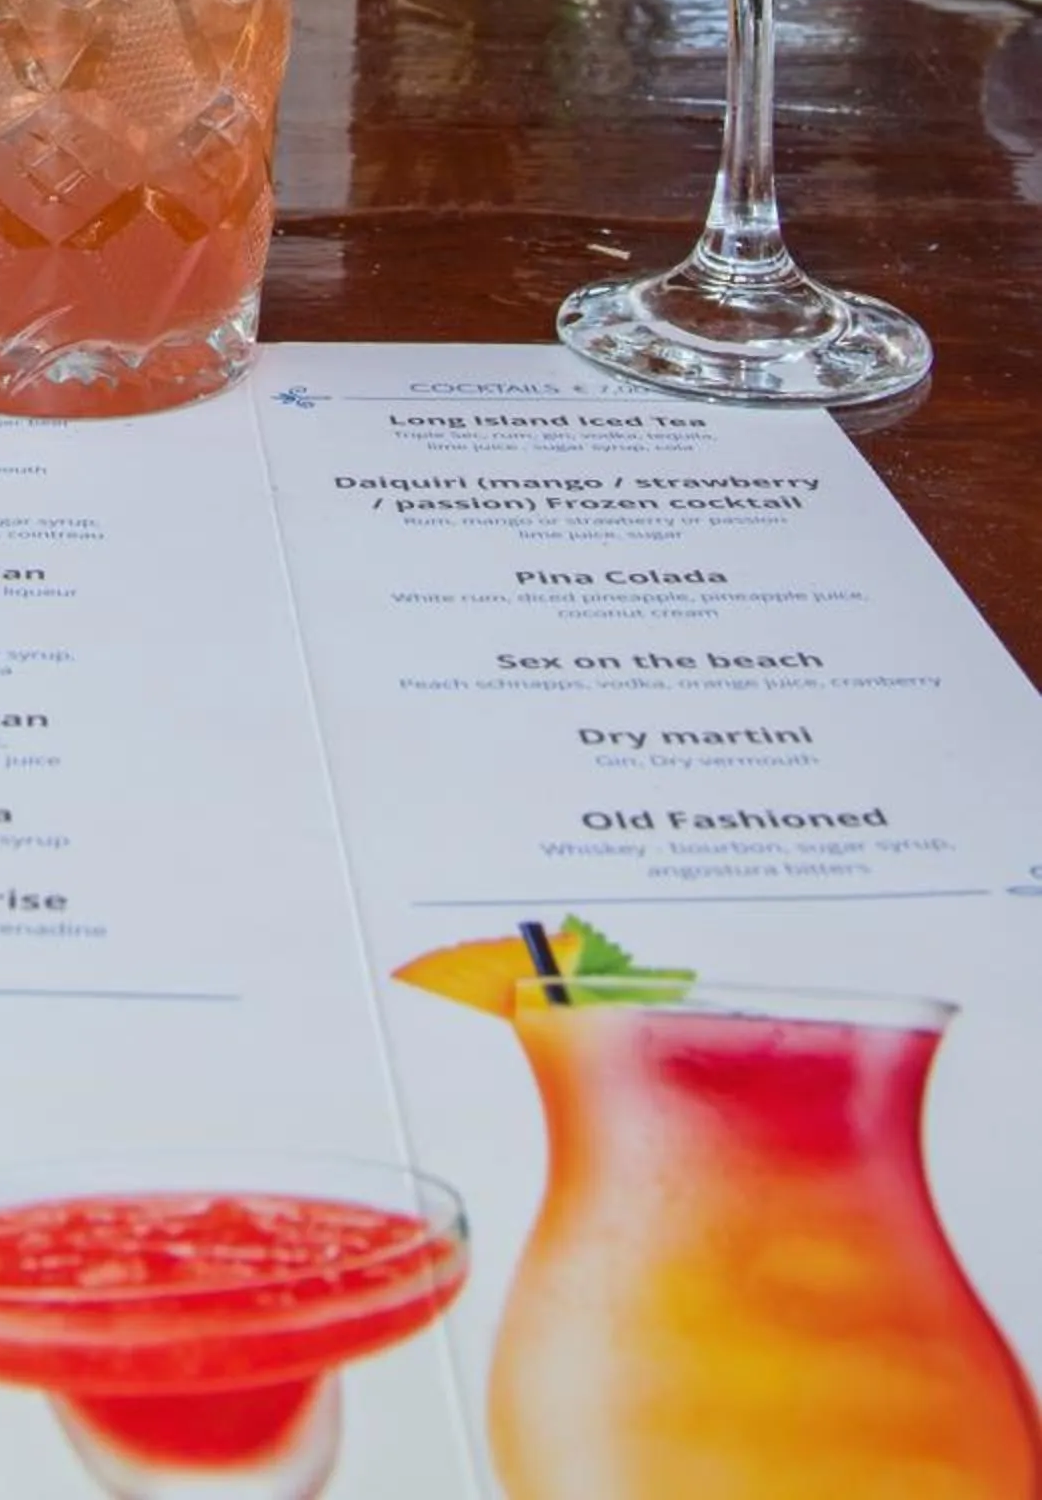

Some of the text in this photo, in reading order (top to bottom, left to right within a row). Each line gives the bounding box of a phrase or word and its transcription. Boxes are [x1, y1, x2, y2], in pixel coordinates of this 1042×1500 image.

[410, 382, 560, 394] COCKTAILS
[389, 415, 706, 428] Long Island Iced Tea
[427, 442, 467, 451] lime
[534, 443, 584, 453] sugar
[655, 443, 694, 452] cola
[334, 476, 819, 491] Daiquiri (mango / strawberry
[372, 496, 802, 513] / passion) Frozen cocktail
[462, 517, 533, 528] mango
[566, 516, 674, 528] strawberry
[709, 515, 788, 527] passion
[8, 530, 104, 541] cointreau
[519, 529, 563, 540] lime
[626, 530, 682, 541] sugar
[516, 570, 728, 585] Pina Colada
[3, 585, 76, 599] liqueur
[391, 592, 454, 604] White
[517, 591, 575, 604] diced
[700, 590, 808, 605] pineapple
[558, 608, 718, 619] coconut cream
[497, 652, 823, 669] Sex on the beach
[399, 678, 469, 690] Peach
[677, 679, 759, 691] orange
[830, 675, 941, 688] cranberry
[578, 727, 813, 749] Dry martini
[5, 754, 61, 770] juice
[649, 754, 693, 770] Dry
[698, 753, 820, 768] vermouth
[582, 808, 888, 830] Old Fashioned
[0, 834, 70, 850] syrup
[539, 842, 646, 858] Whiskey
[797, 841, 865, 856] sugar
[647, 862, 872, 881] angostura bitters
